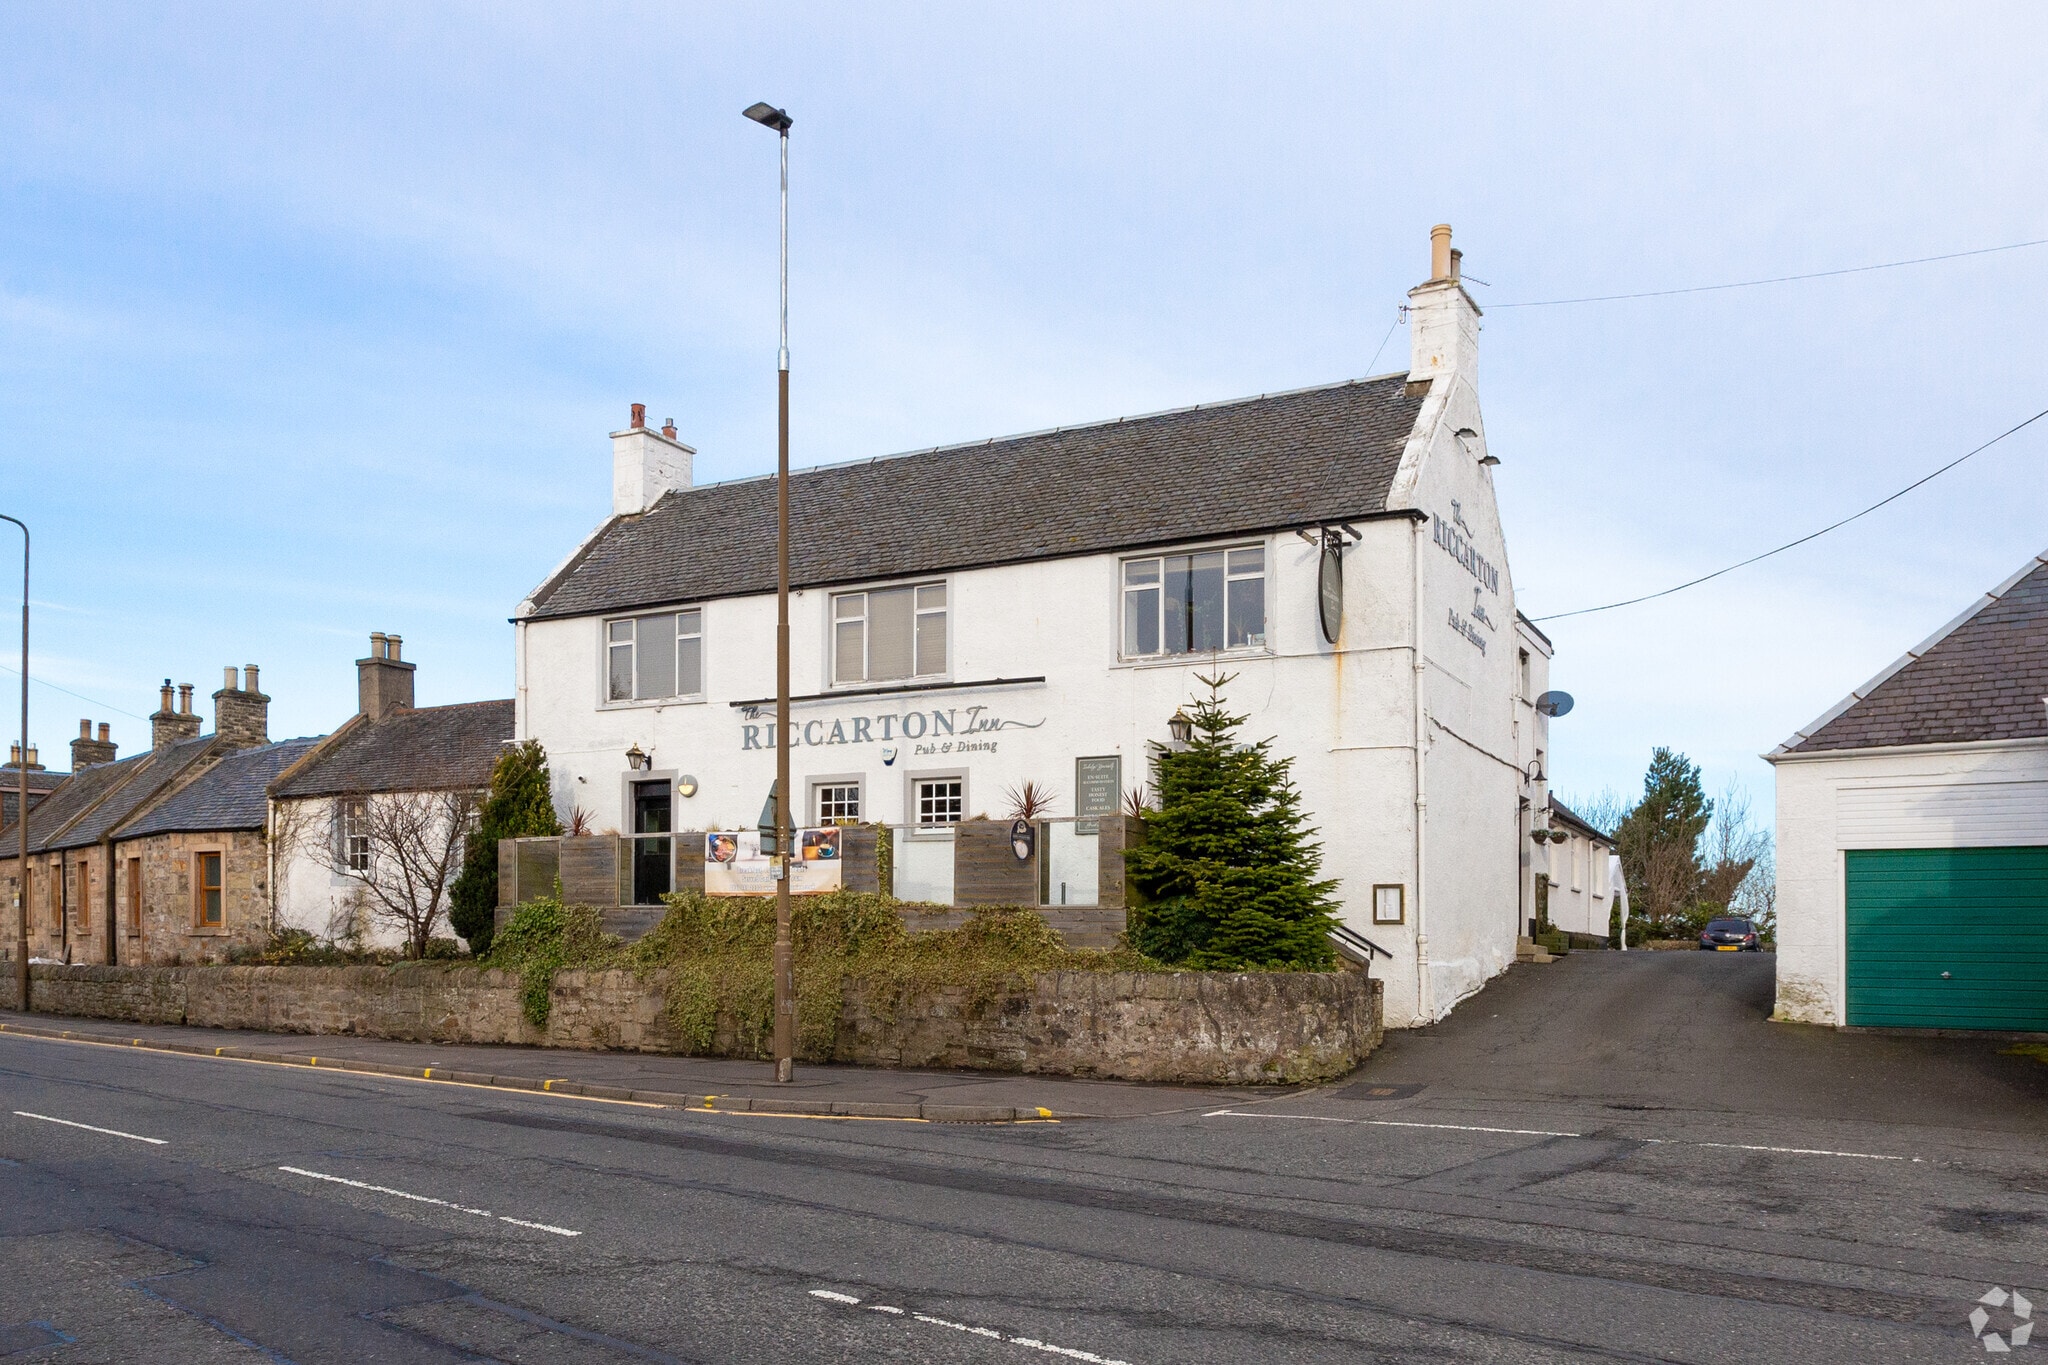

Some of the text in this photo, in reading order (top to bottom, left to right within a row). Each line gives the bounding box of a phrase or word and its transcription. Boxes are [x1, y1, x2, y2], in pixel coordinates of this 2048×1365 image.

[1433, 512, 1498, 596] RICCARTON
[742, 705, 776, 722] The
[960, 704, 1047, 735] Inn
[914, 740, 998, 756] Pub & Dining
